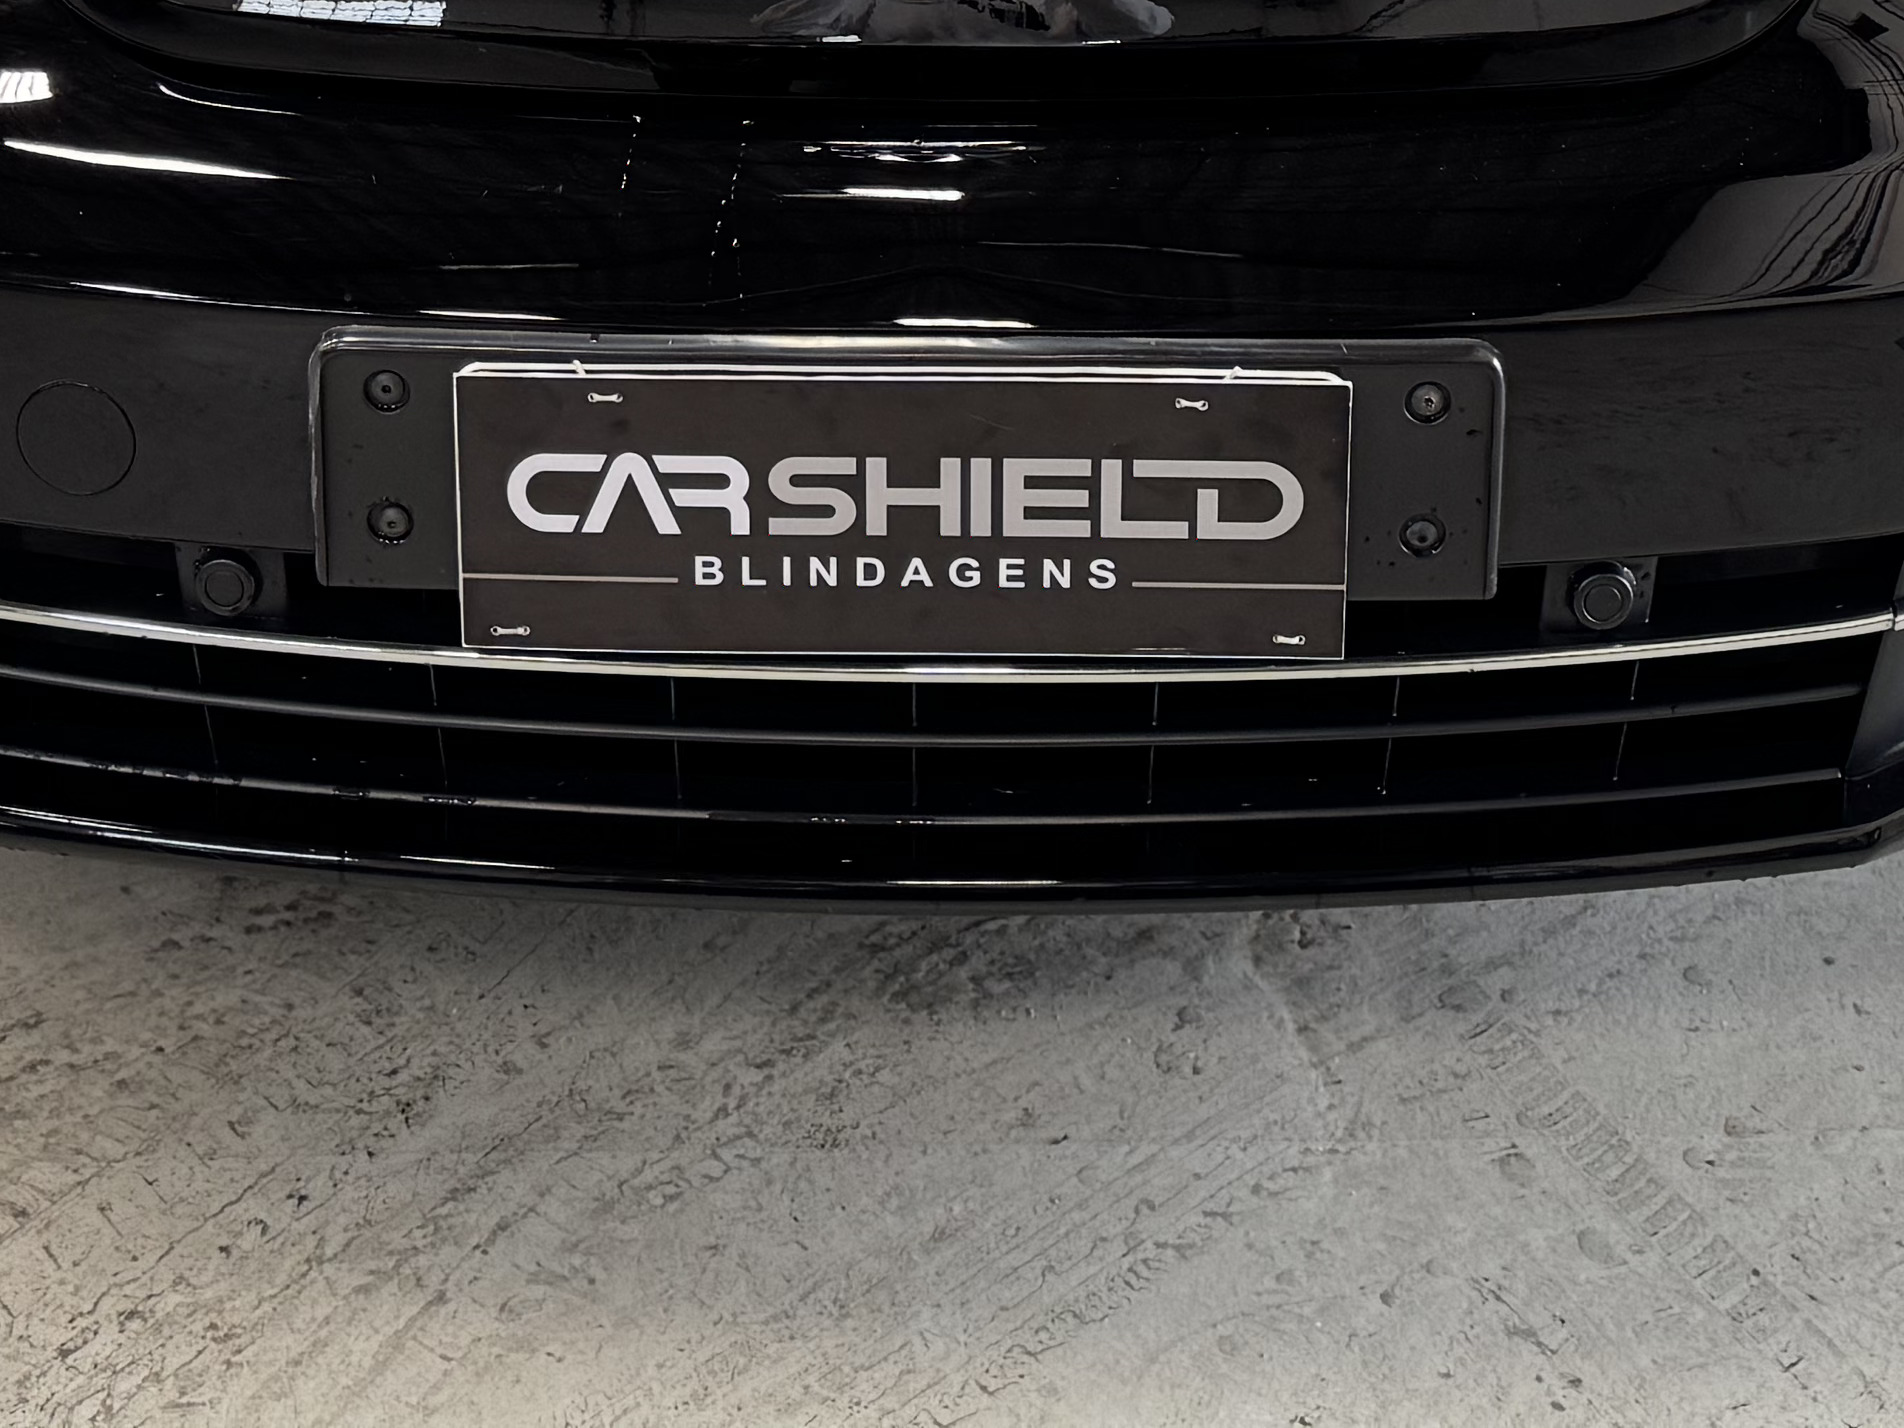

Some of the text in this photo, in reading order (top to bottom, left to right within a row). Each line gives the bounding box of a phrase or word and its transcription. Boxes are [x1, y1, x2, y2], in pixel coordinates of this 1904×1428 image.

[507, 450, 1306, 540] CAR SHIELD
[694, 555, 1118, 590] BLINDAGENS
